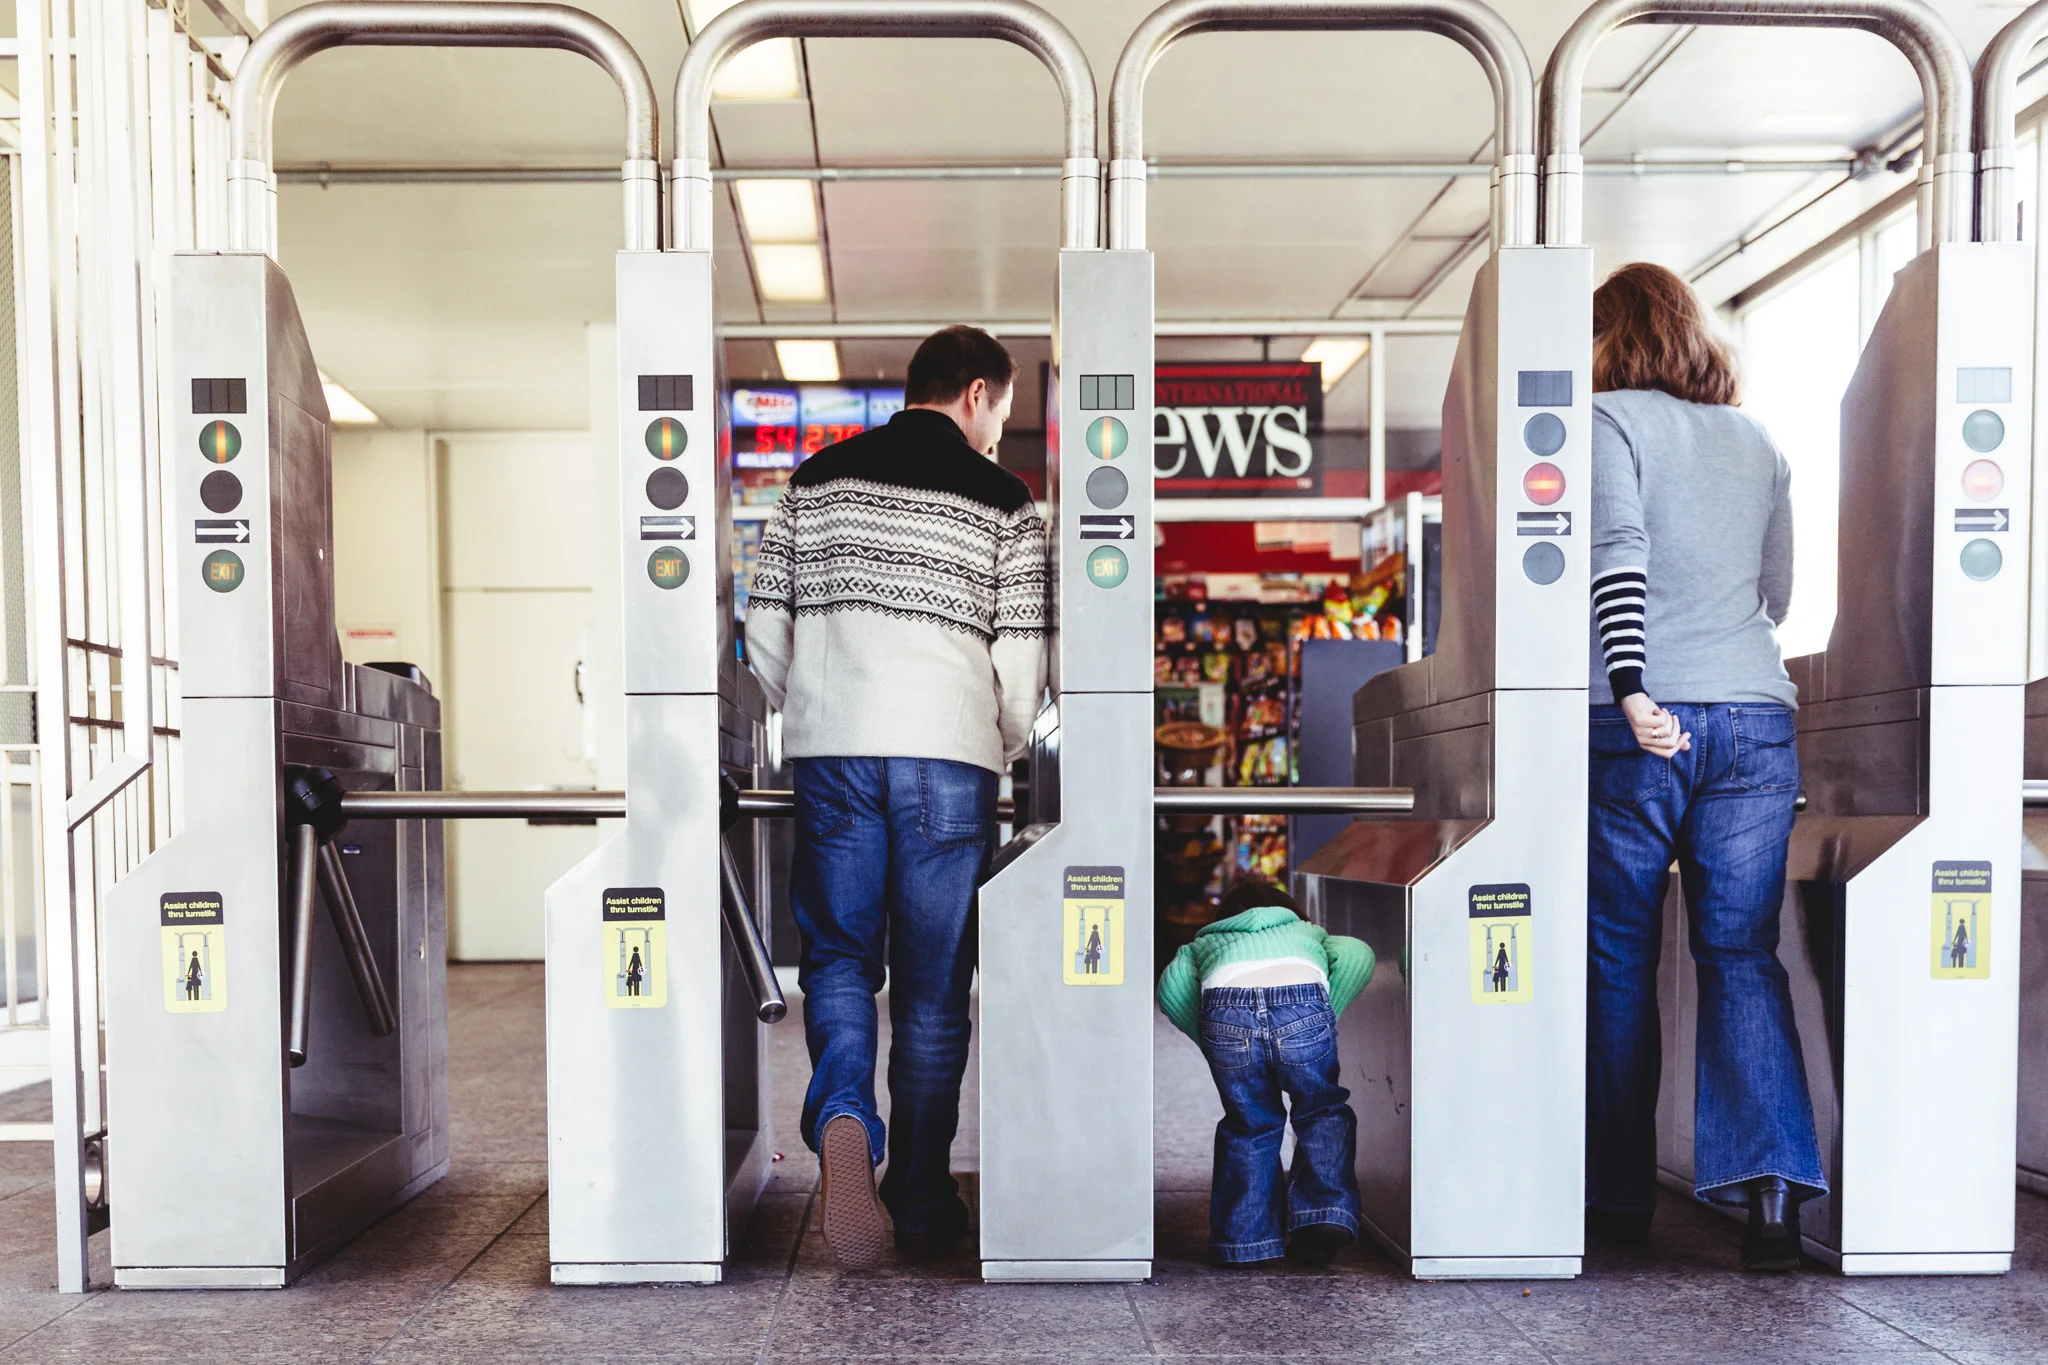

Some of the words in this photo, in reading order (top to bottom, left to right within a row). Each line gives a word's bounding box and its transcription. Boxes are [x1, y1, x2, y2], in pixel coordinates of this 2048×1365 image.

[755, 424, 797, 454] 54
[210, 562, 237, 580] EXIT
[655, 559, 682, 577] EXIT
[1093, 558, 1120, 577] EXIT
[189, 901, 220, 909] children
[606, 897, 629, 905] Assist
[1493, 901, 1525, 909] turnstile
[627, 905, 658, 913] turnstile
